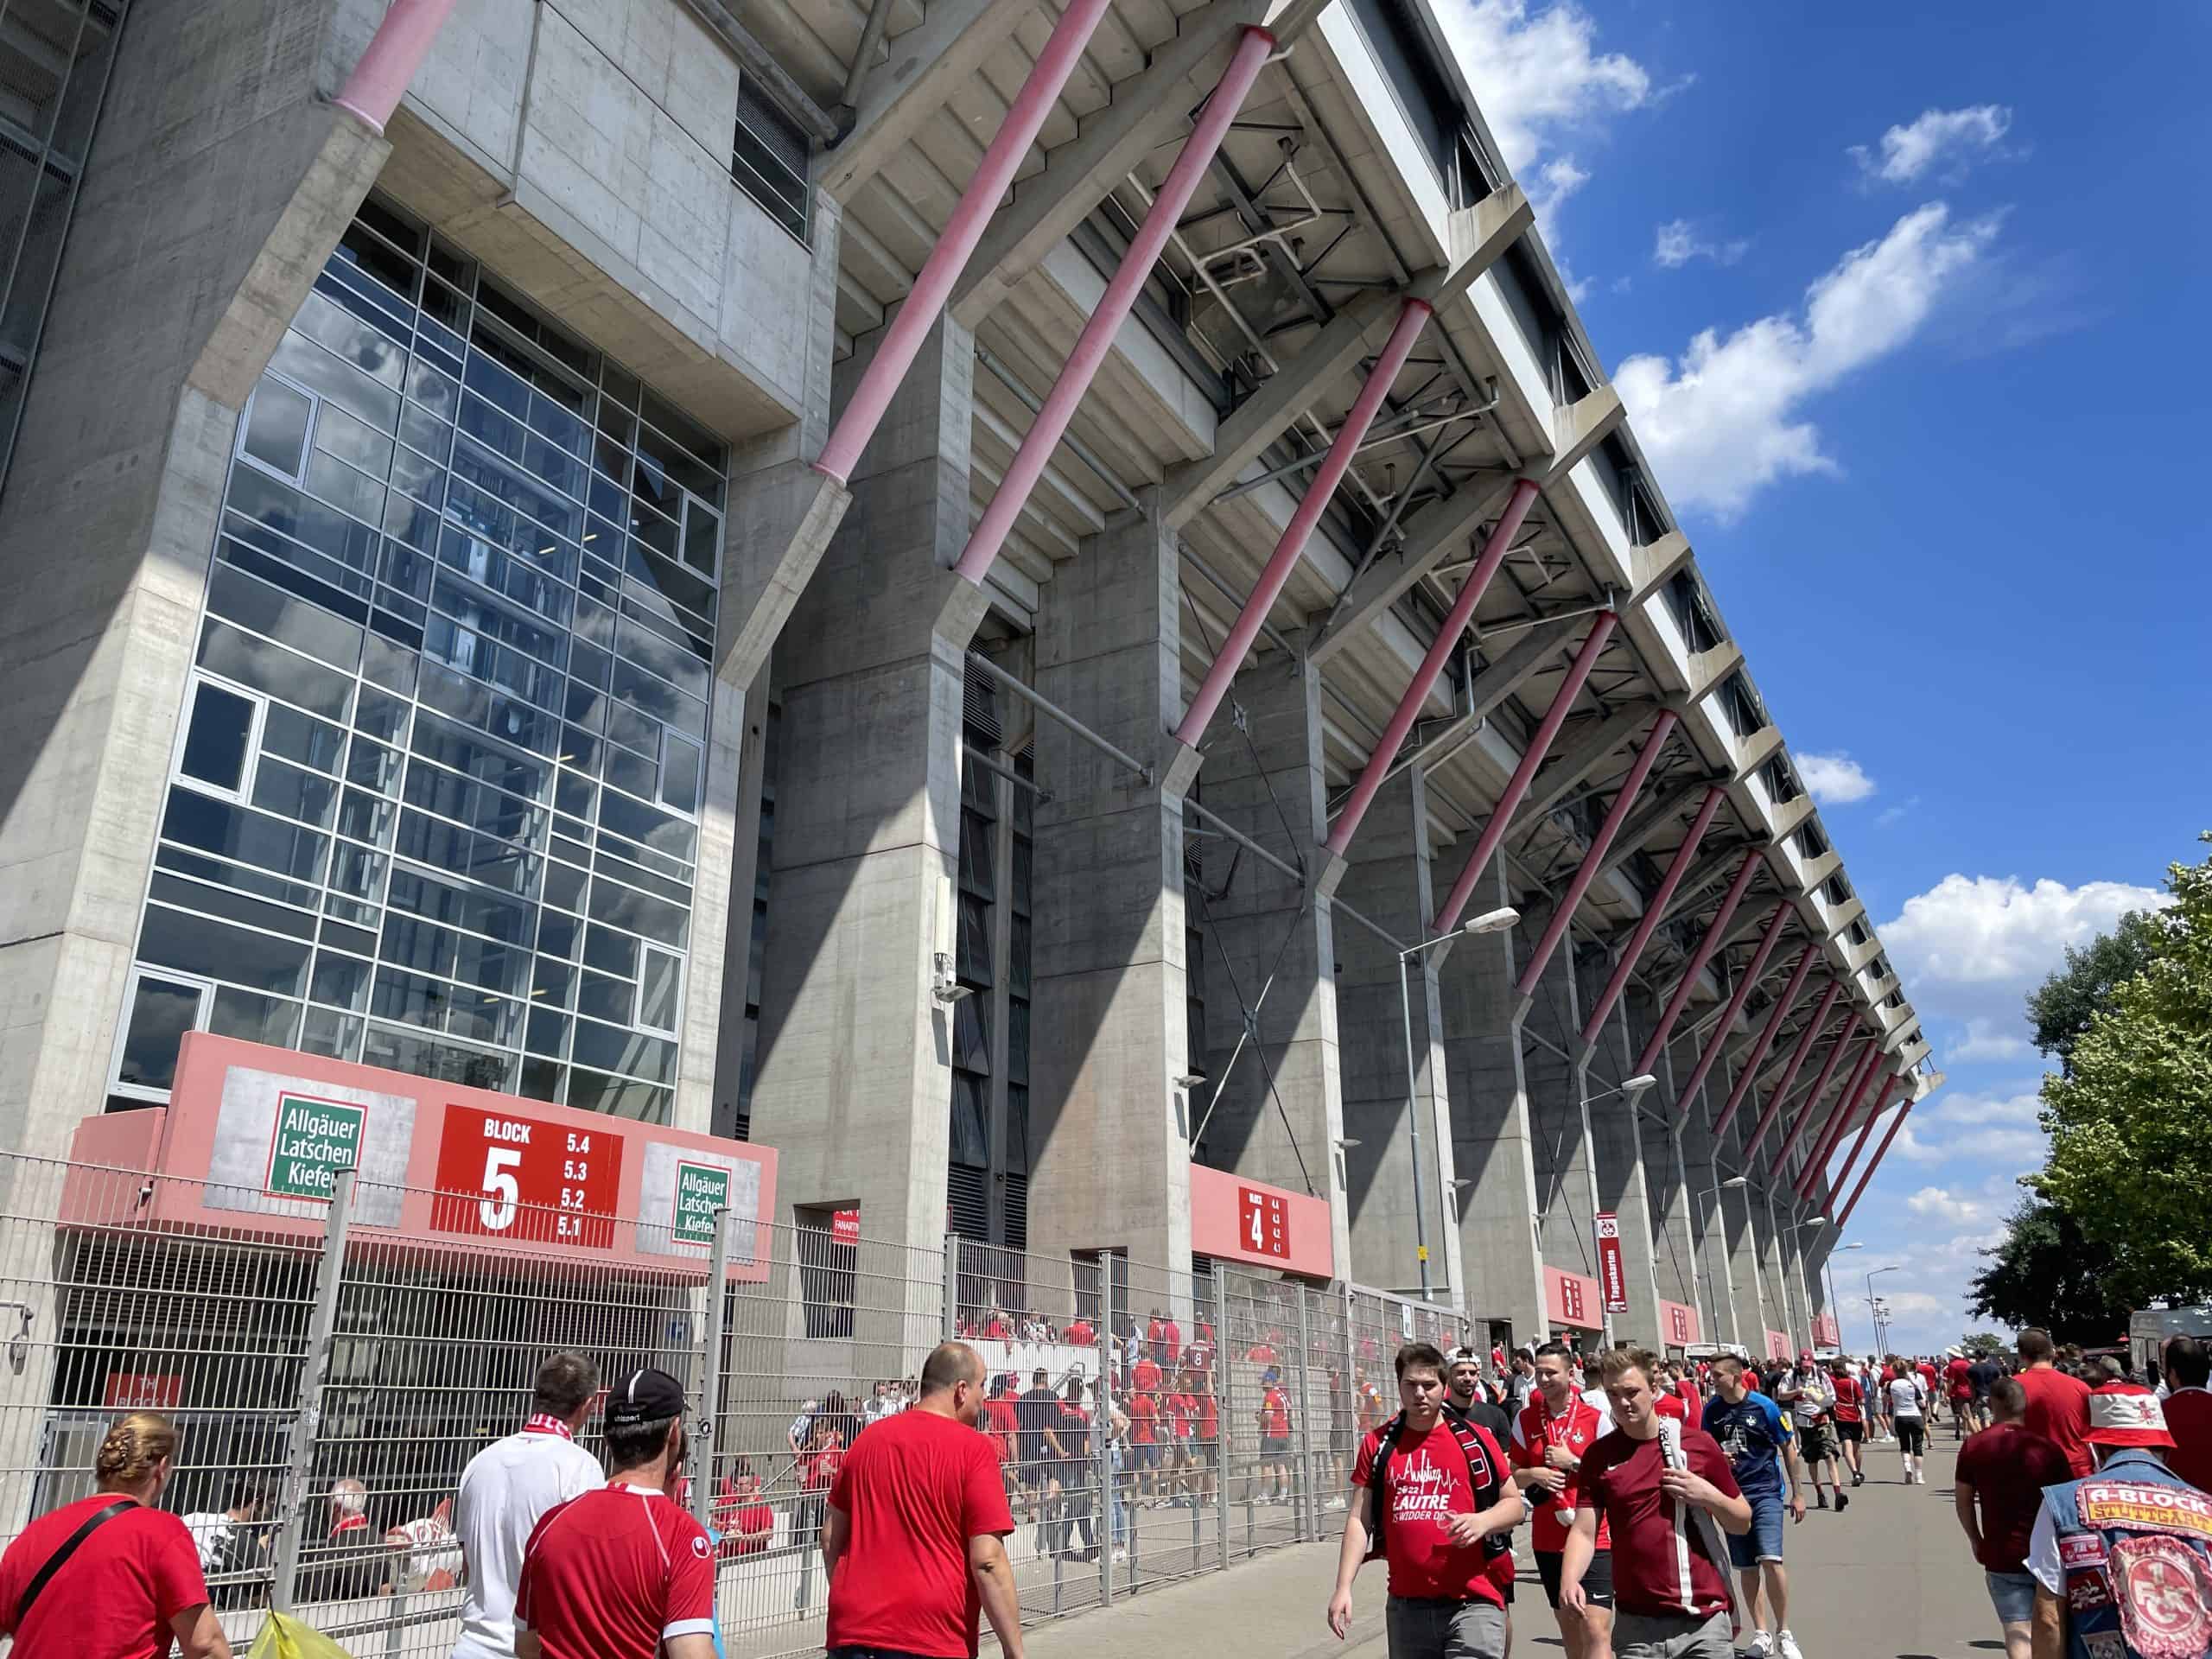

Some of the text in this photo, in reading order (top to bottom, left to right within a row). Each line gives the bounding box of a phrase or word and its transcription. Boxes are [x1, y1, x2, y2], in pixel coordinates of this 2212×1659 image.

[285, 1108, 356, 1139] Allgäuer
[483, 1118, 531, 1144] BLOCK
[280, 1133, 352, 1165] Latschen
[567, 1133, 590, 1154] 5.4
[564, 1160, 587, 1181] 5.3
[480, 1147, 521, 1230] 5
[682, 1173, 725, 1197] Allgäuer
[562, 1188, 584, 1208] 5.2
[557, 1216, 581, 1236] 5.1
[1251, 1208, 1263, 1249] 4
[1194, 1352, 1202, 1366] 8
[1393, 1494, 1450, 1511] LAUTRE
[2089, 1488, 2210, 1516] A-BLOCK
[2093, 1503, 2211, 1530] STUTTGART
